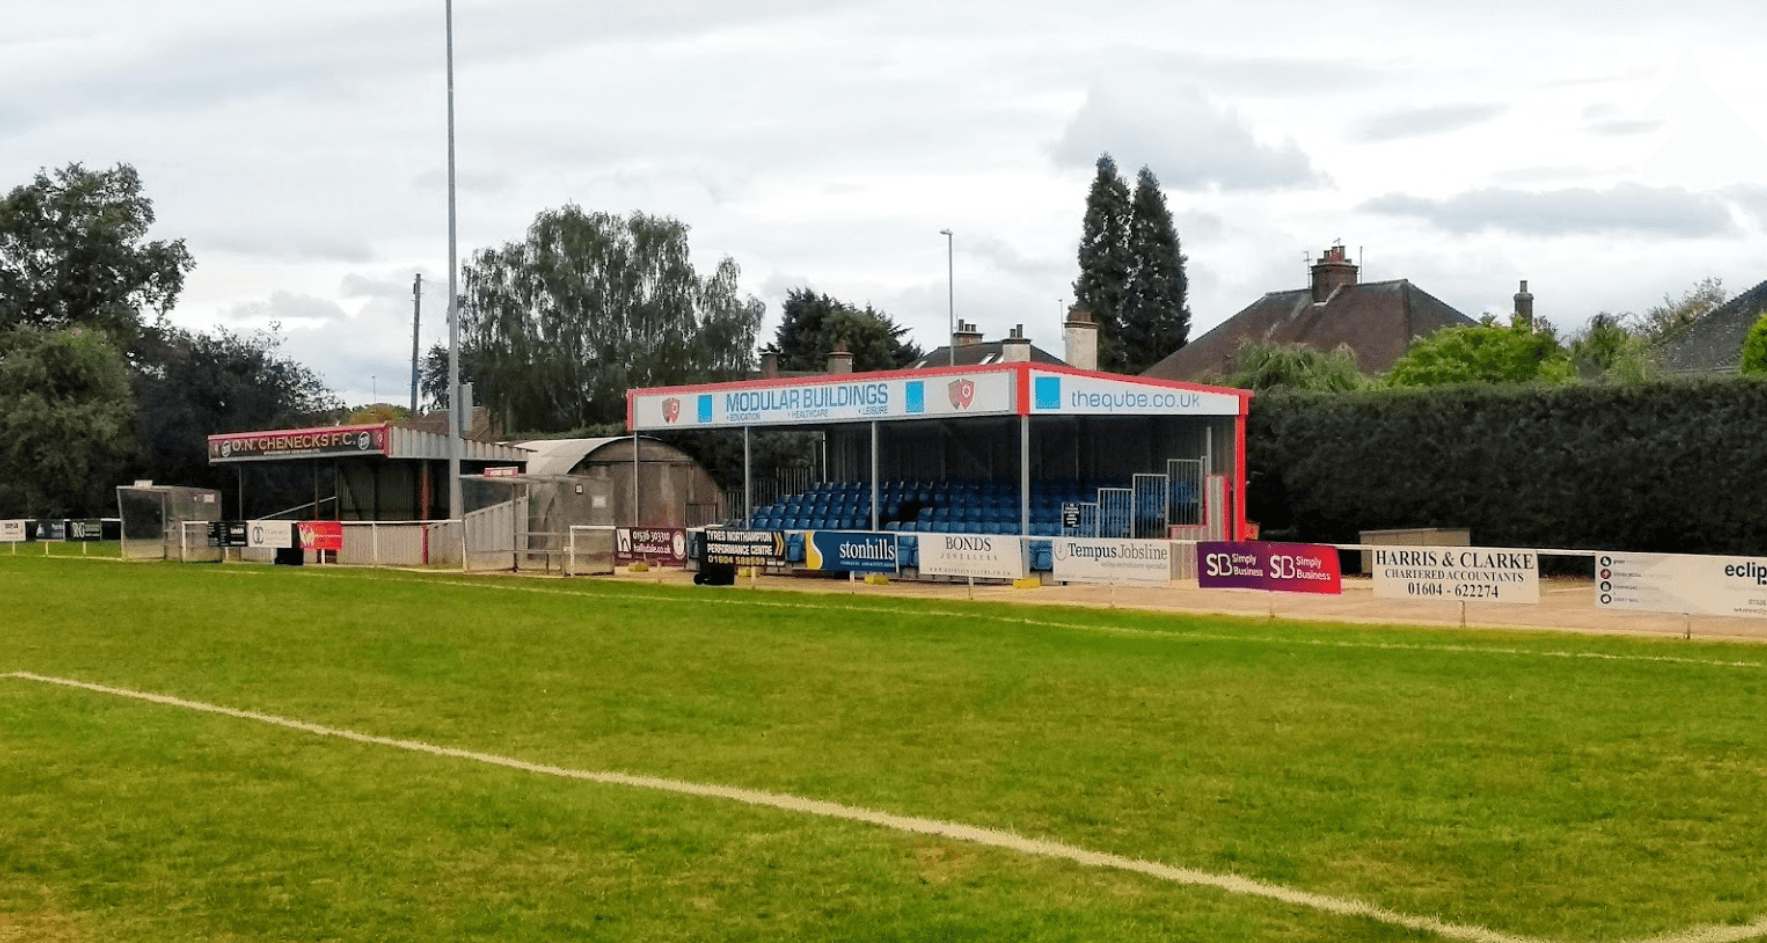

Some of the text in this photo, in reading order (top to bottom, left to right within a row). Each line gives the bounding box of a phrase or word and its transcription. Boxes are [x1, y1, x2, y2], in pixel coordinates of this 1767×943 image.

[726, 383, 888, 412] MODULAR BUILDINGS
[1071, 390, 1201, 411] theqube.co.uk
[730, 412, 760, 421] EDUCATION
[791, 409, 828, 418] HEALTHCARE
[862, 405, 888, 415] LEISURE
[232, 439, 256, 451] O.N.
[260, 434, 329, 450] CHENECKS
[331, 432, 356, 446] F.C.
[706, 530, 772, 542] TYRES NORTHAMPTON
[707, 543, 773, 556] PERFORMANCE CENTRE
[839, 538, 895, 560] stonhills
[945, 536, 991, 551] BONDS
[1067, 543, 1168, 562] Tempus Jobsline
[1232, 553, 1257, 566] Simply
[1296, 556, 1322, 569] Simply
[1376, 550, 1534, 570] HARRIS & CLARKE
[1233, 566, 1263, 577] Business
[1296, 568, 1331, 580] Business
[1385, 568, 1524, 583] CHARTERED ACCOUNTANTS
[1408, 582, 1442, 596] 01604
[1455, 583, 1499, 598] 622274
